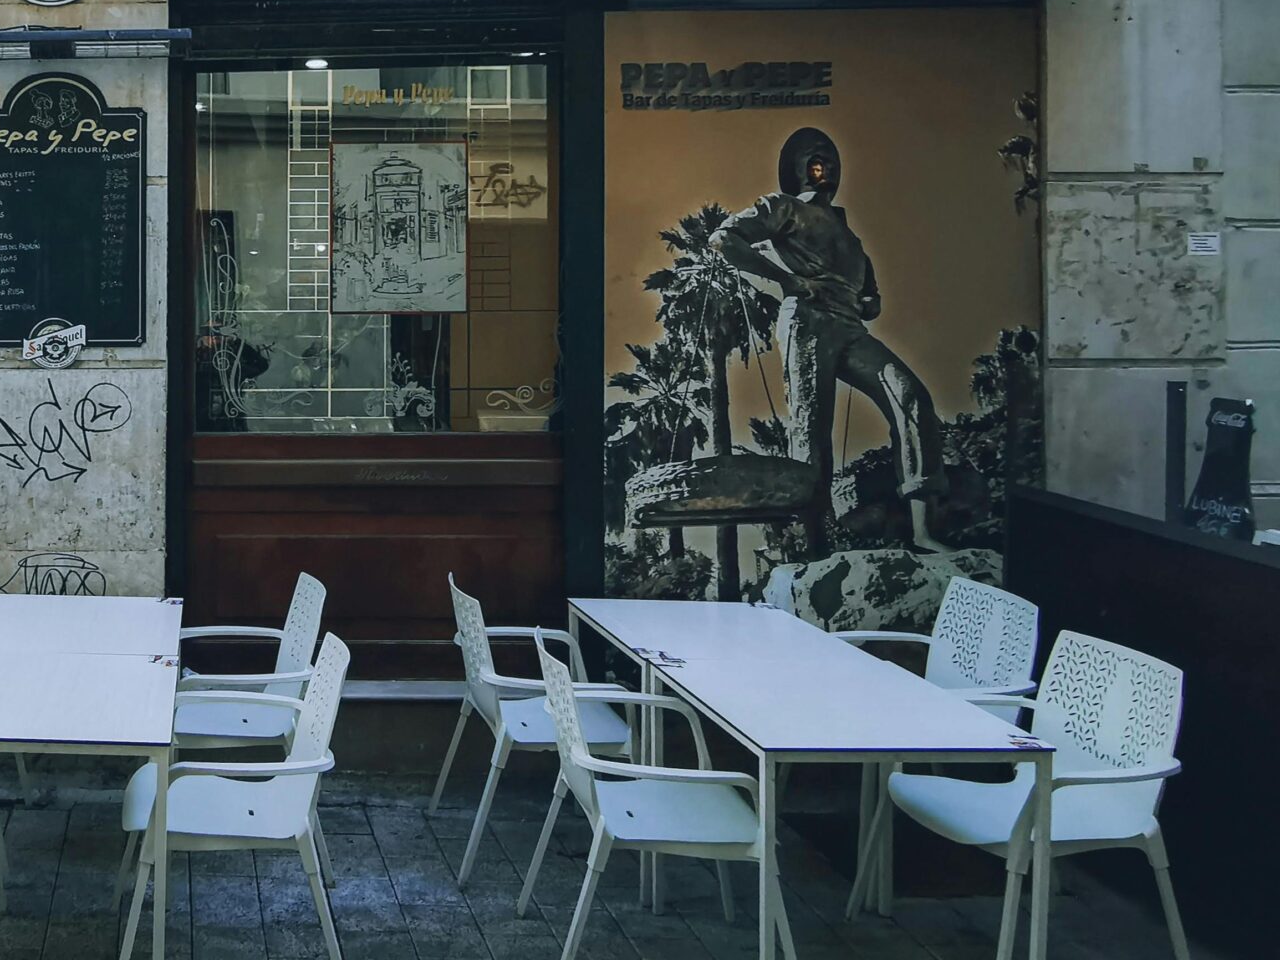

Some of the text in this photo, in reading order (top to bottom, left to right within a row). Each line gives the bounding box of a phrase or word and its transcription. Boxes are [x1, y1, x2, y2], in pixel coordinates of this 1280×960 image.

[620, 62, 712, 90] PEPA
[742, 61, 833, 89] PEPE
[342, 84, 387, 108] Pepa
[622, 93, 652, 108] Bar
[656, 92, 677, 107] de
[682, 92, 733, 110] Tapas
[733, 94, 747, 110] y
[40, 129, 63, 155] y
[71, 118, 138, 146] Pepe
